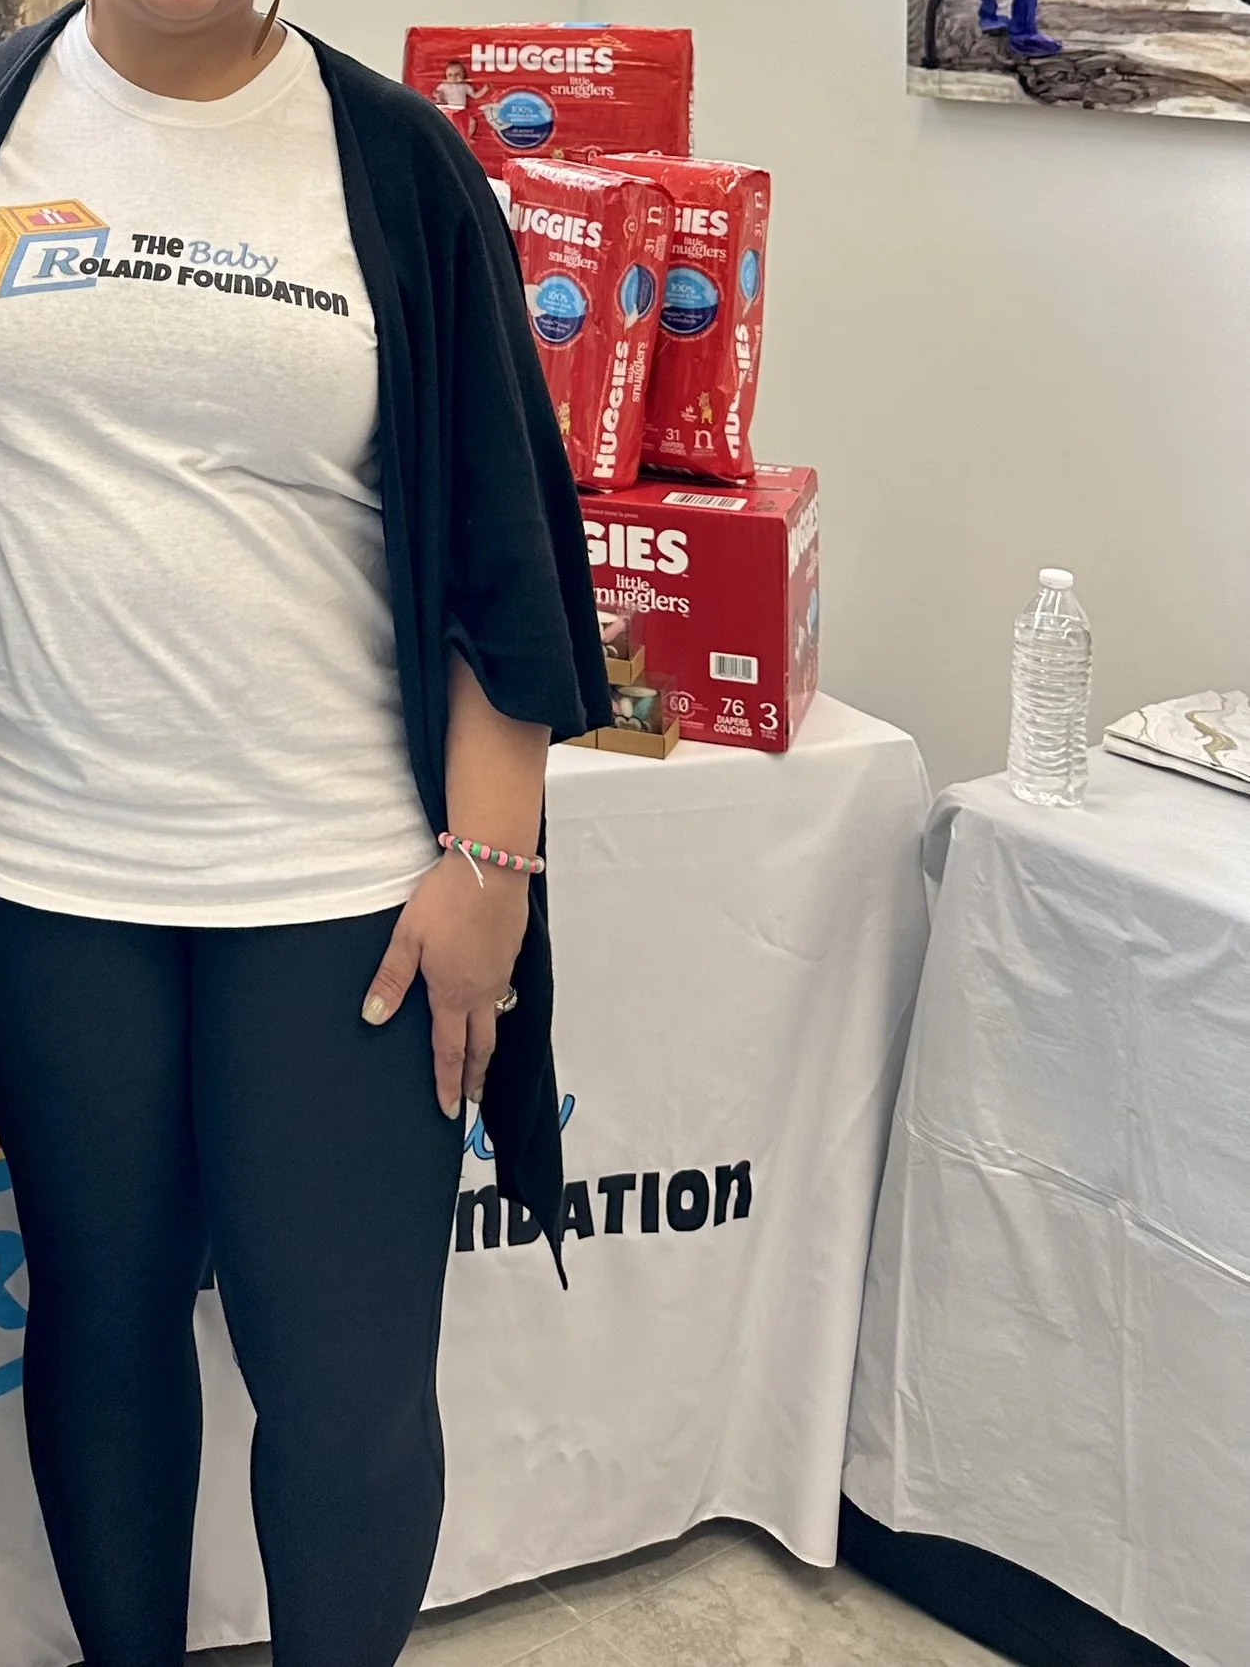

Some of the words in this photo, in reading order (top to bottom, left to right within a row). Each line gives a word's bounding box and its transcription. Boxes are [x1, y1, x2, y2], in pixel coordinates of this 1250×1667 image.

[470, 44, 613, 74] HUGGIES
[550, 83, 614, 97] snugglers
[187, 240, 279, 278] Baby
[548, 250, 598, 272] snugglers
[672, 243, 726, 259] nugglers
[632, 342, 647, 403] snugglers
[592, 340, 629, 479] HUGGIES
[665, 427, 680, 441] 31
[583, 520, 689, 575] GIES
[615, 573, 650, 591] little
[595, 586, 690, 614] nugglers
[720, 697, 745, 717] 76
[758, 702, 779, 731] 3
[713, 722, 753, 737] COUCHES
[716, 716, 750, 728] DIAPERS
